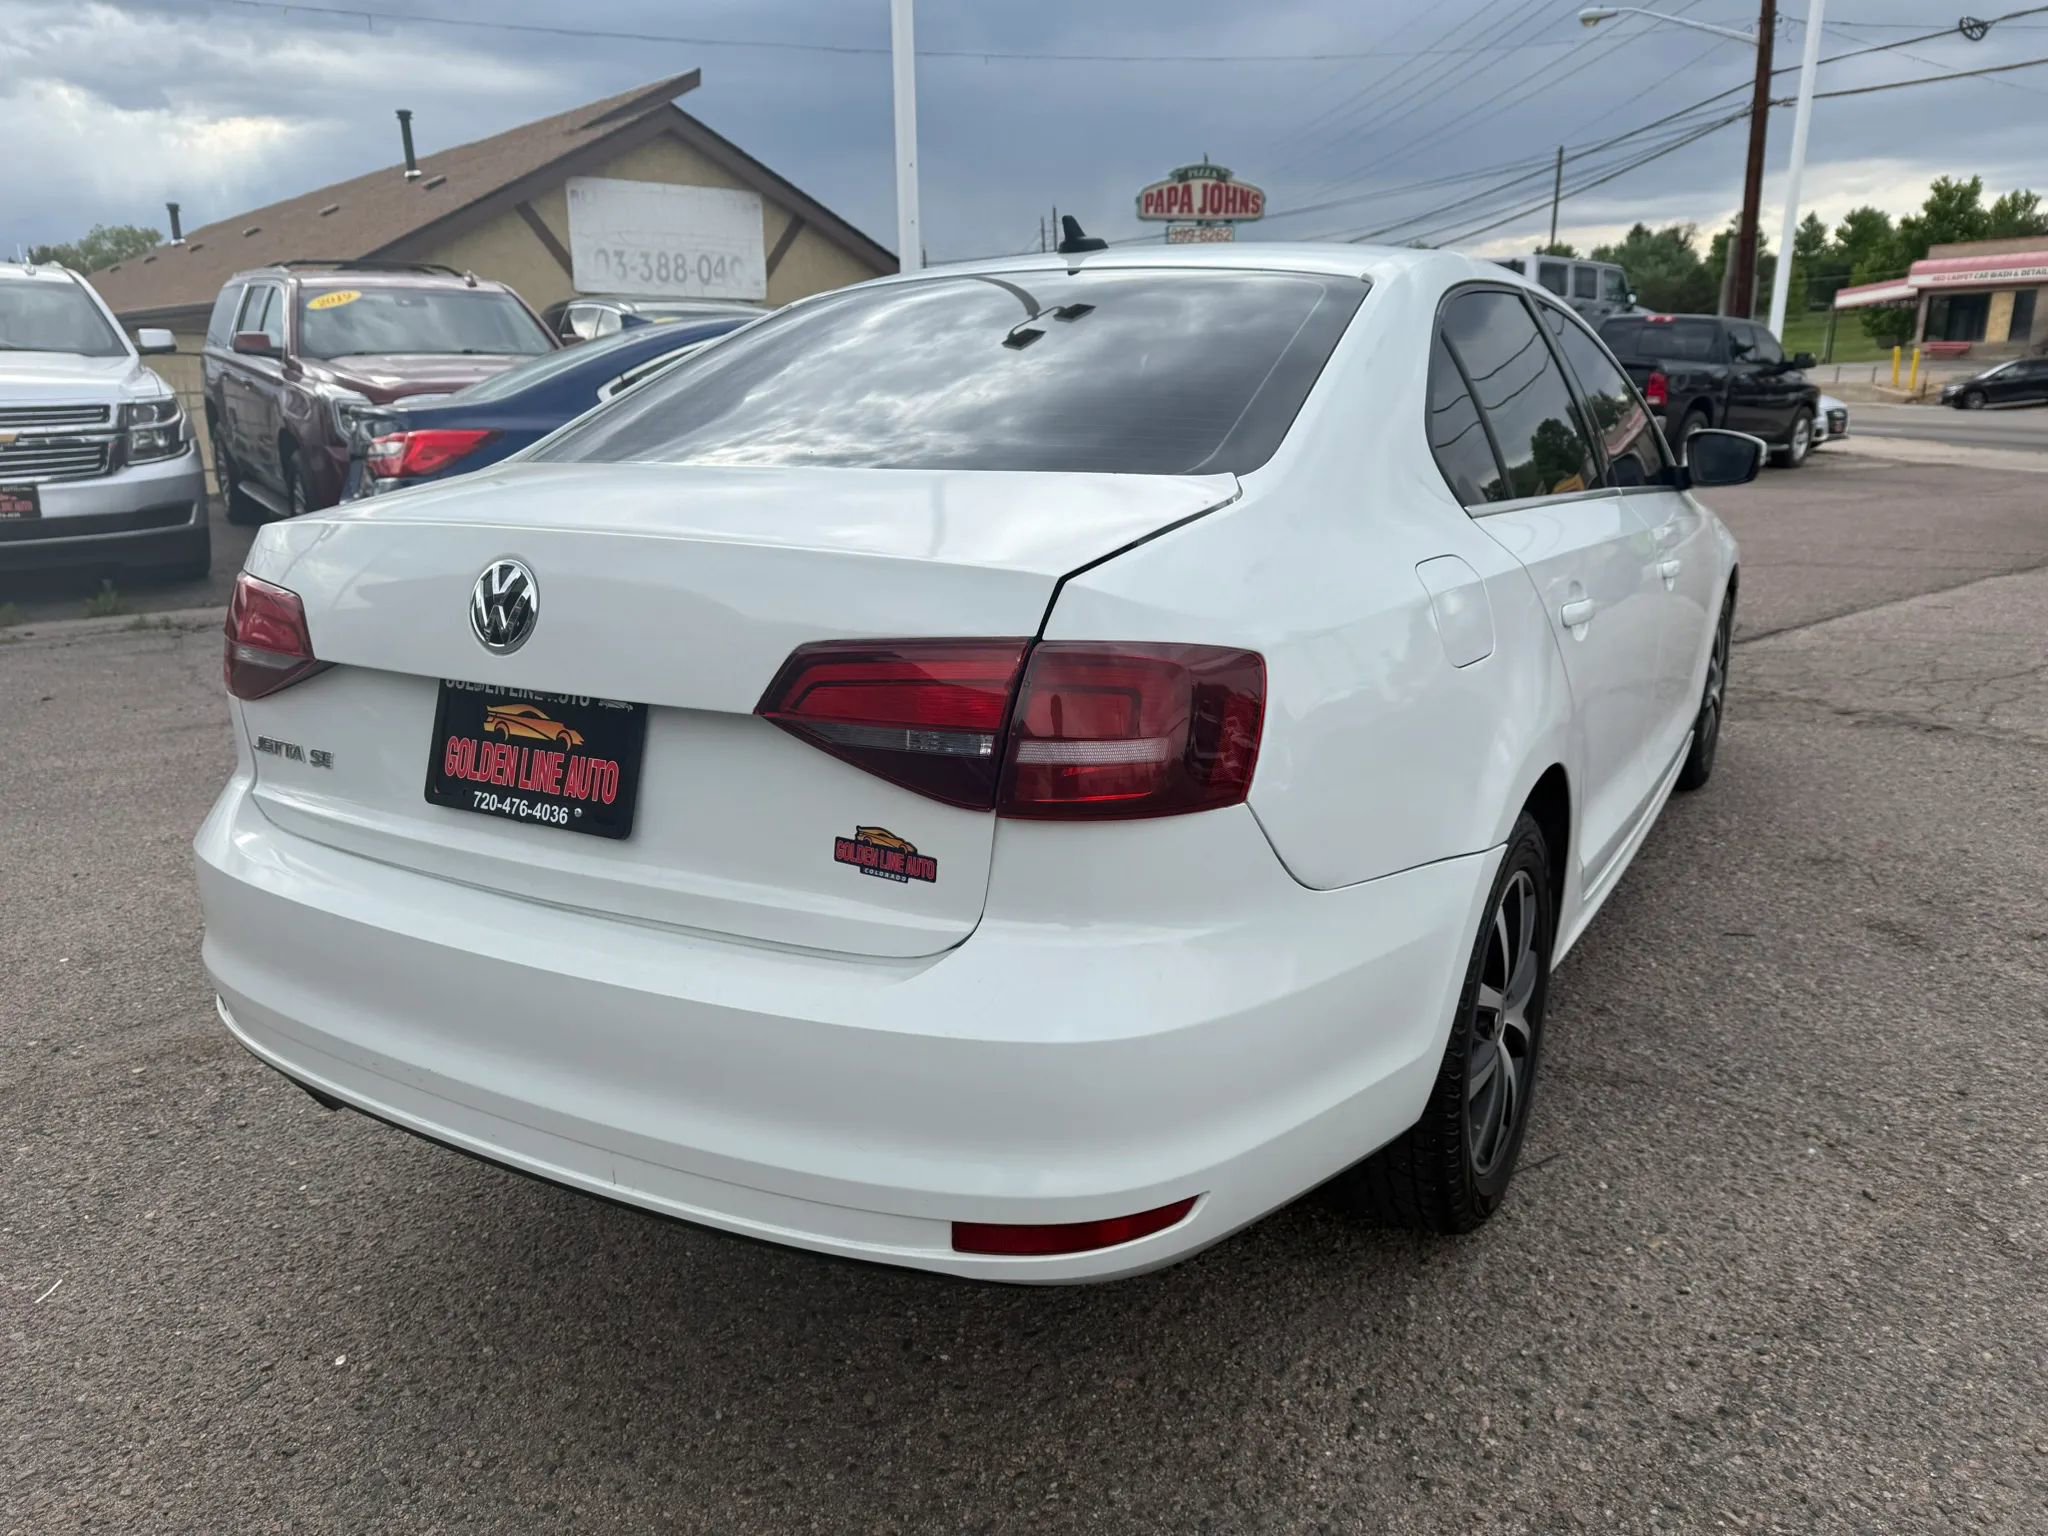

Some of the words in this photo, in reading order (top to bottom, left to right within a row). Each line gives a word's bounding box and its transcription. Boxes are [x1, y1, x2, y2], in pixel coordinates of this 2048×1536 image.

[1144, 184, 1194, 214] PAPA
[1198, 183, 1261, 214] JOHNS
[253, 735, 306, 763] JETTA
[309, 749, 334, 770] SE
[444, 735, 519, 787] GOLDEN
[518, 747, 565, 796] LINE
[563, 754, 620, 805] AUTO
[473, 791, 569, 825] 720-476-4036
[836, 840, 879, 868] GOLDEN
[879, 848, 906, 874] LINE
[905, 855, 935, 879] AUTO
[864, 867, 908, 882] COLORADO
